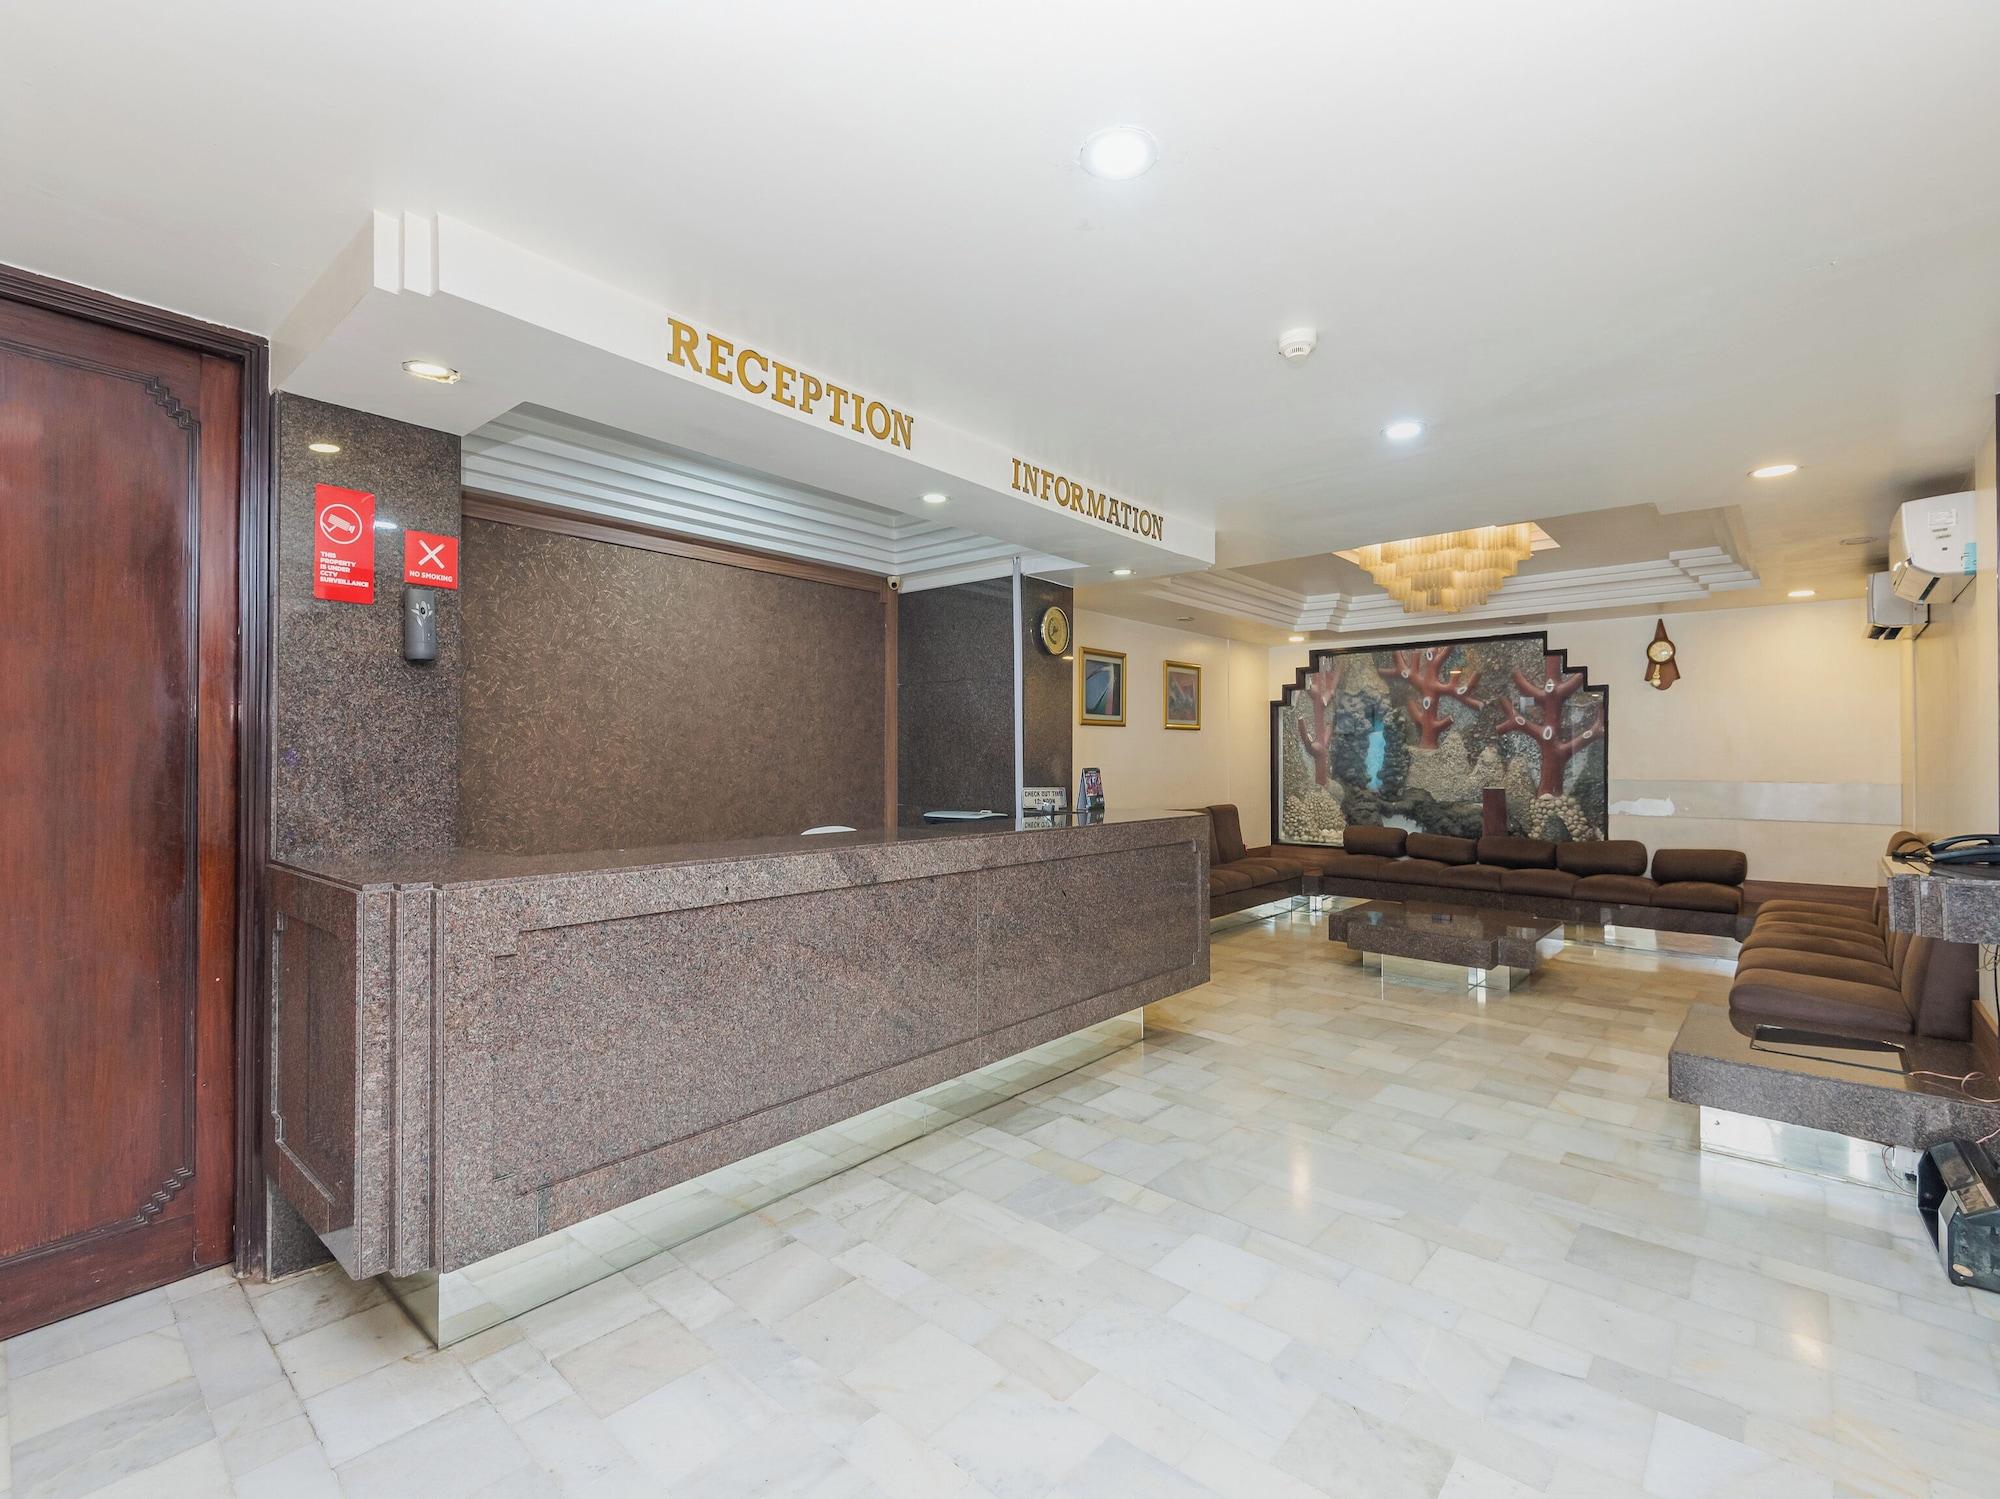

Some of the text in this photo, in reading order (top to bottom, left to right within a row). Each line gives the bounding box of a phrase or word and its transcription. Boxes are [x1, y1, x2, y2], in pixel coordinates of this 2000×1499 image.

[667, 317, 914, 450] RECEPTION
[1011, 457, 1164, 541] INFORMATION
[320, 557, 356, 567] PROPERTY
[327, 564, 350, 573] UNDER
[320, 576, 369, 588] SURVEILLANCE
[409, 570, 453, 582] NO SMOKING
